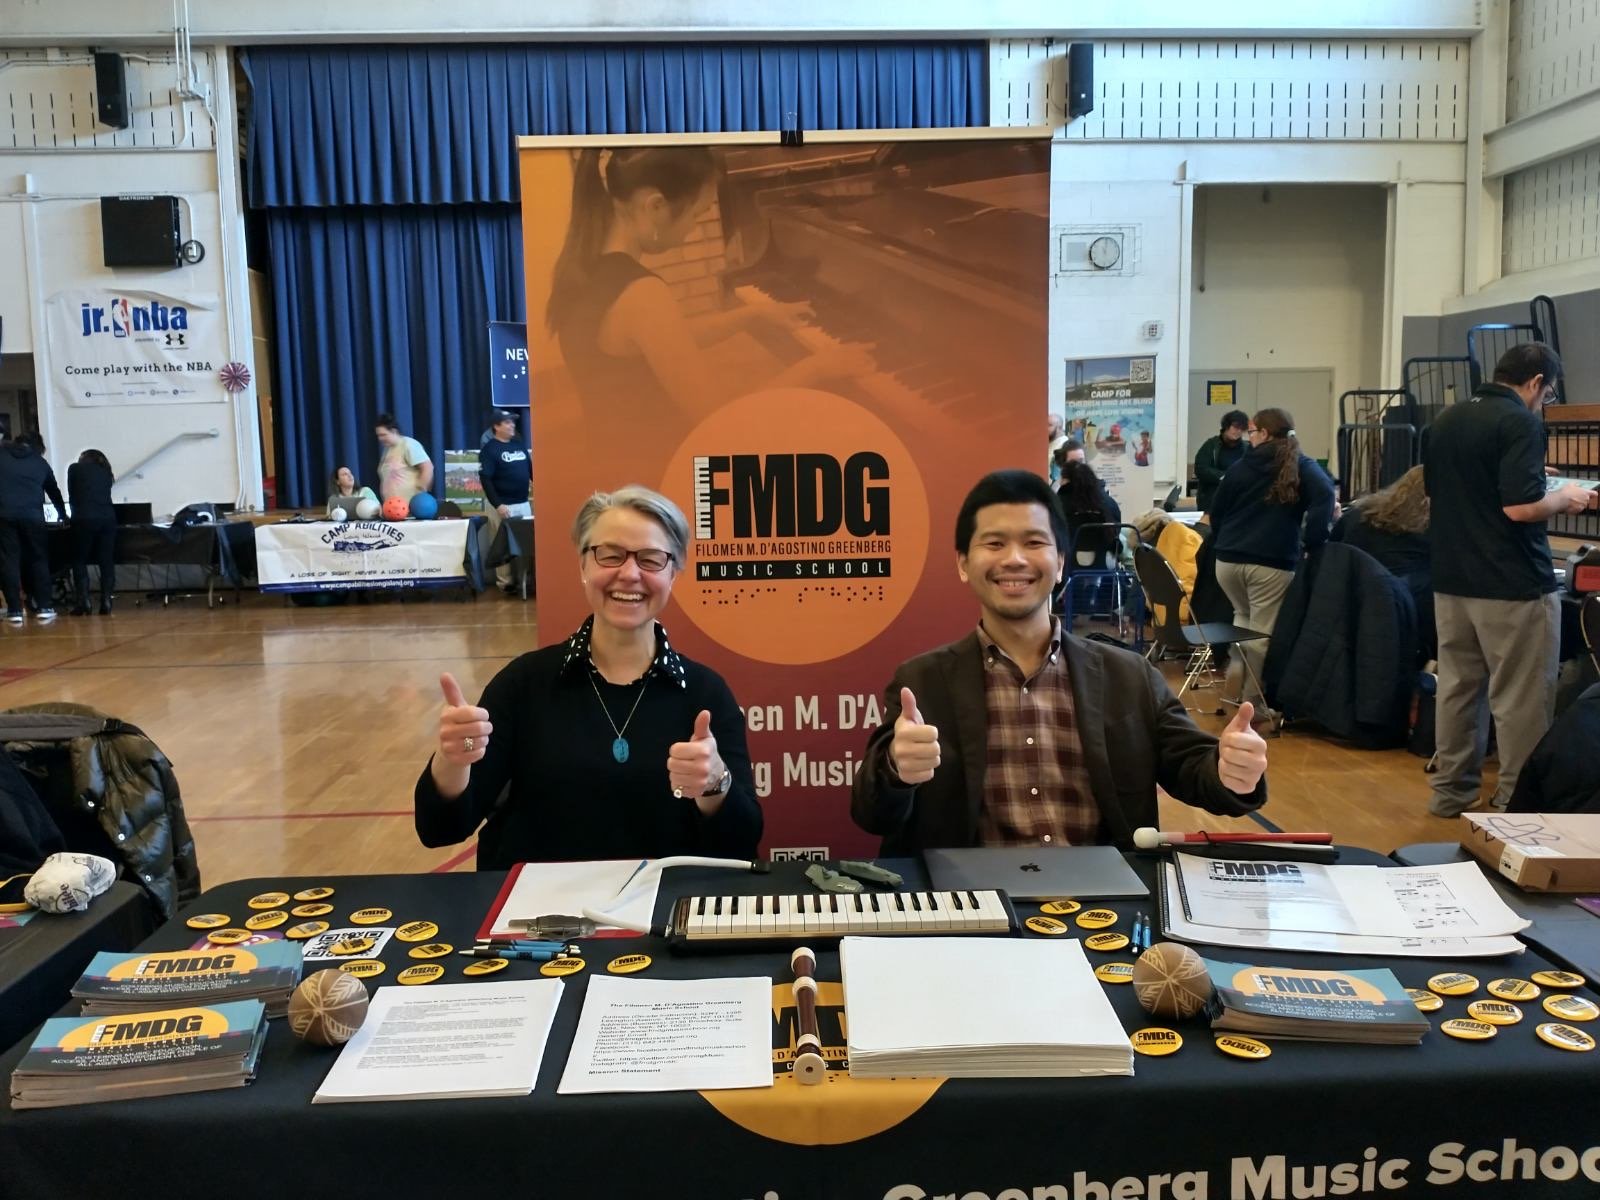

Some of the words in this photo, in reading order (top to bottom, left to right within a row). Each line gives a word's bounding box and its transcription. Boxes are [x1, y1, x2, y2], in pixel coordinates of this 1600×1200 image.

[81, 303, 110, 337] jr.
[132, 301, 189, 332] nba
[65, 365, 100, 376] Come
[103, 364, 130, 376] play
[133, 363, 161, 374] with
[163, 362, 183, 373] the
[187, 362, 213, 372] NBA
[1091, 390, 1114, 399] CAMP
[1115, 389, 1131, 398] FOR
[693, 451, 891, 540] FMDG
[321, 522, 351, 544] CAMP
[355, 521, 405, 542] ABILITIES
[696, 543, 744, 556] FILOMEN
[746, 543, 759, 556] M.
[760, 541, 826, 556] D'AGOSTINO
[828, 540, 892, 555] GREENBERG
[701, 564, 773, 578] MUSIC
[795, 561, 884, 576] SCHOOL
[739, 704, 784, 732] en
[795, 695, 828, 730] M.
[838, 694, 888, 730] D'A
[750, 761, 772, 798] g
[1208, 861, 1303, 877] FMDG
[135, 954, 237, 975] FMDG
[1252, 974, 1358, 997] FMDG
[1475, 1003, 1516, 1014] FMDG
[90, 1015, 205, 1043] FMDG
[1137, 1032, 1176, 1042] FMDG
[1230, 1147, 1412, 1200] Music
[1425, 1138, 1600, 1186] Schoo
